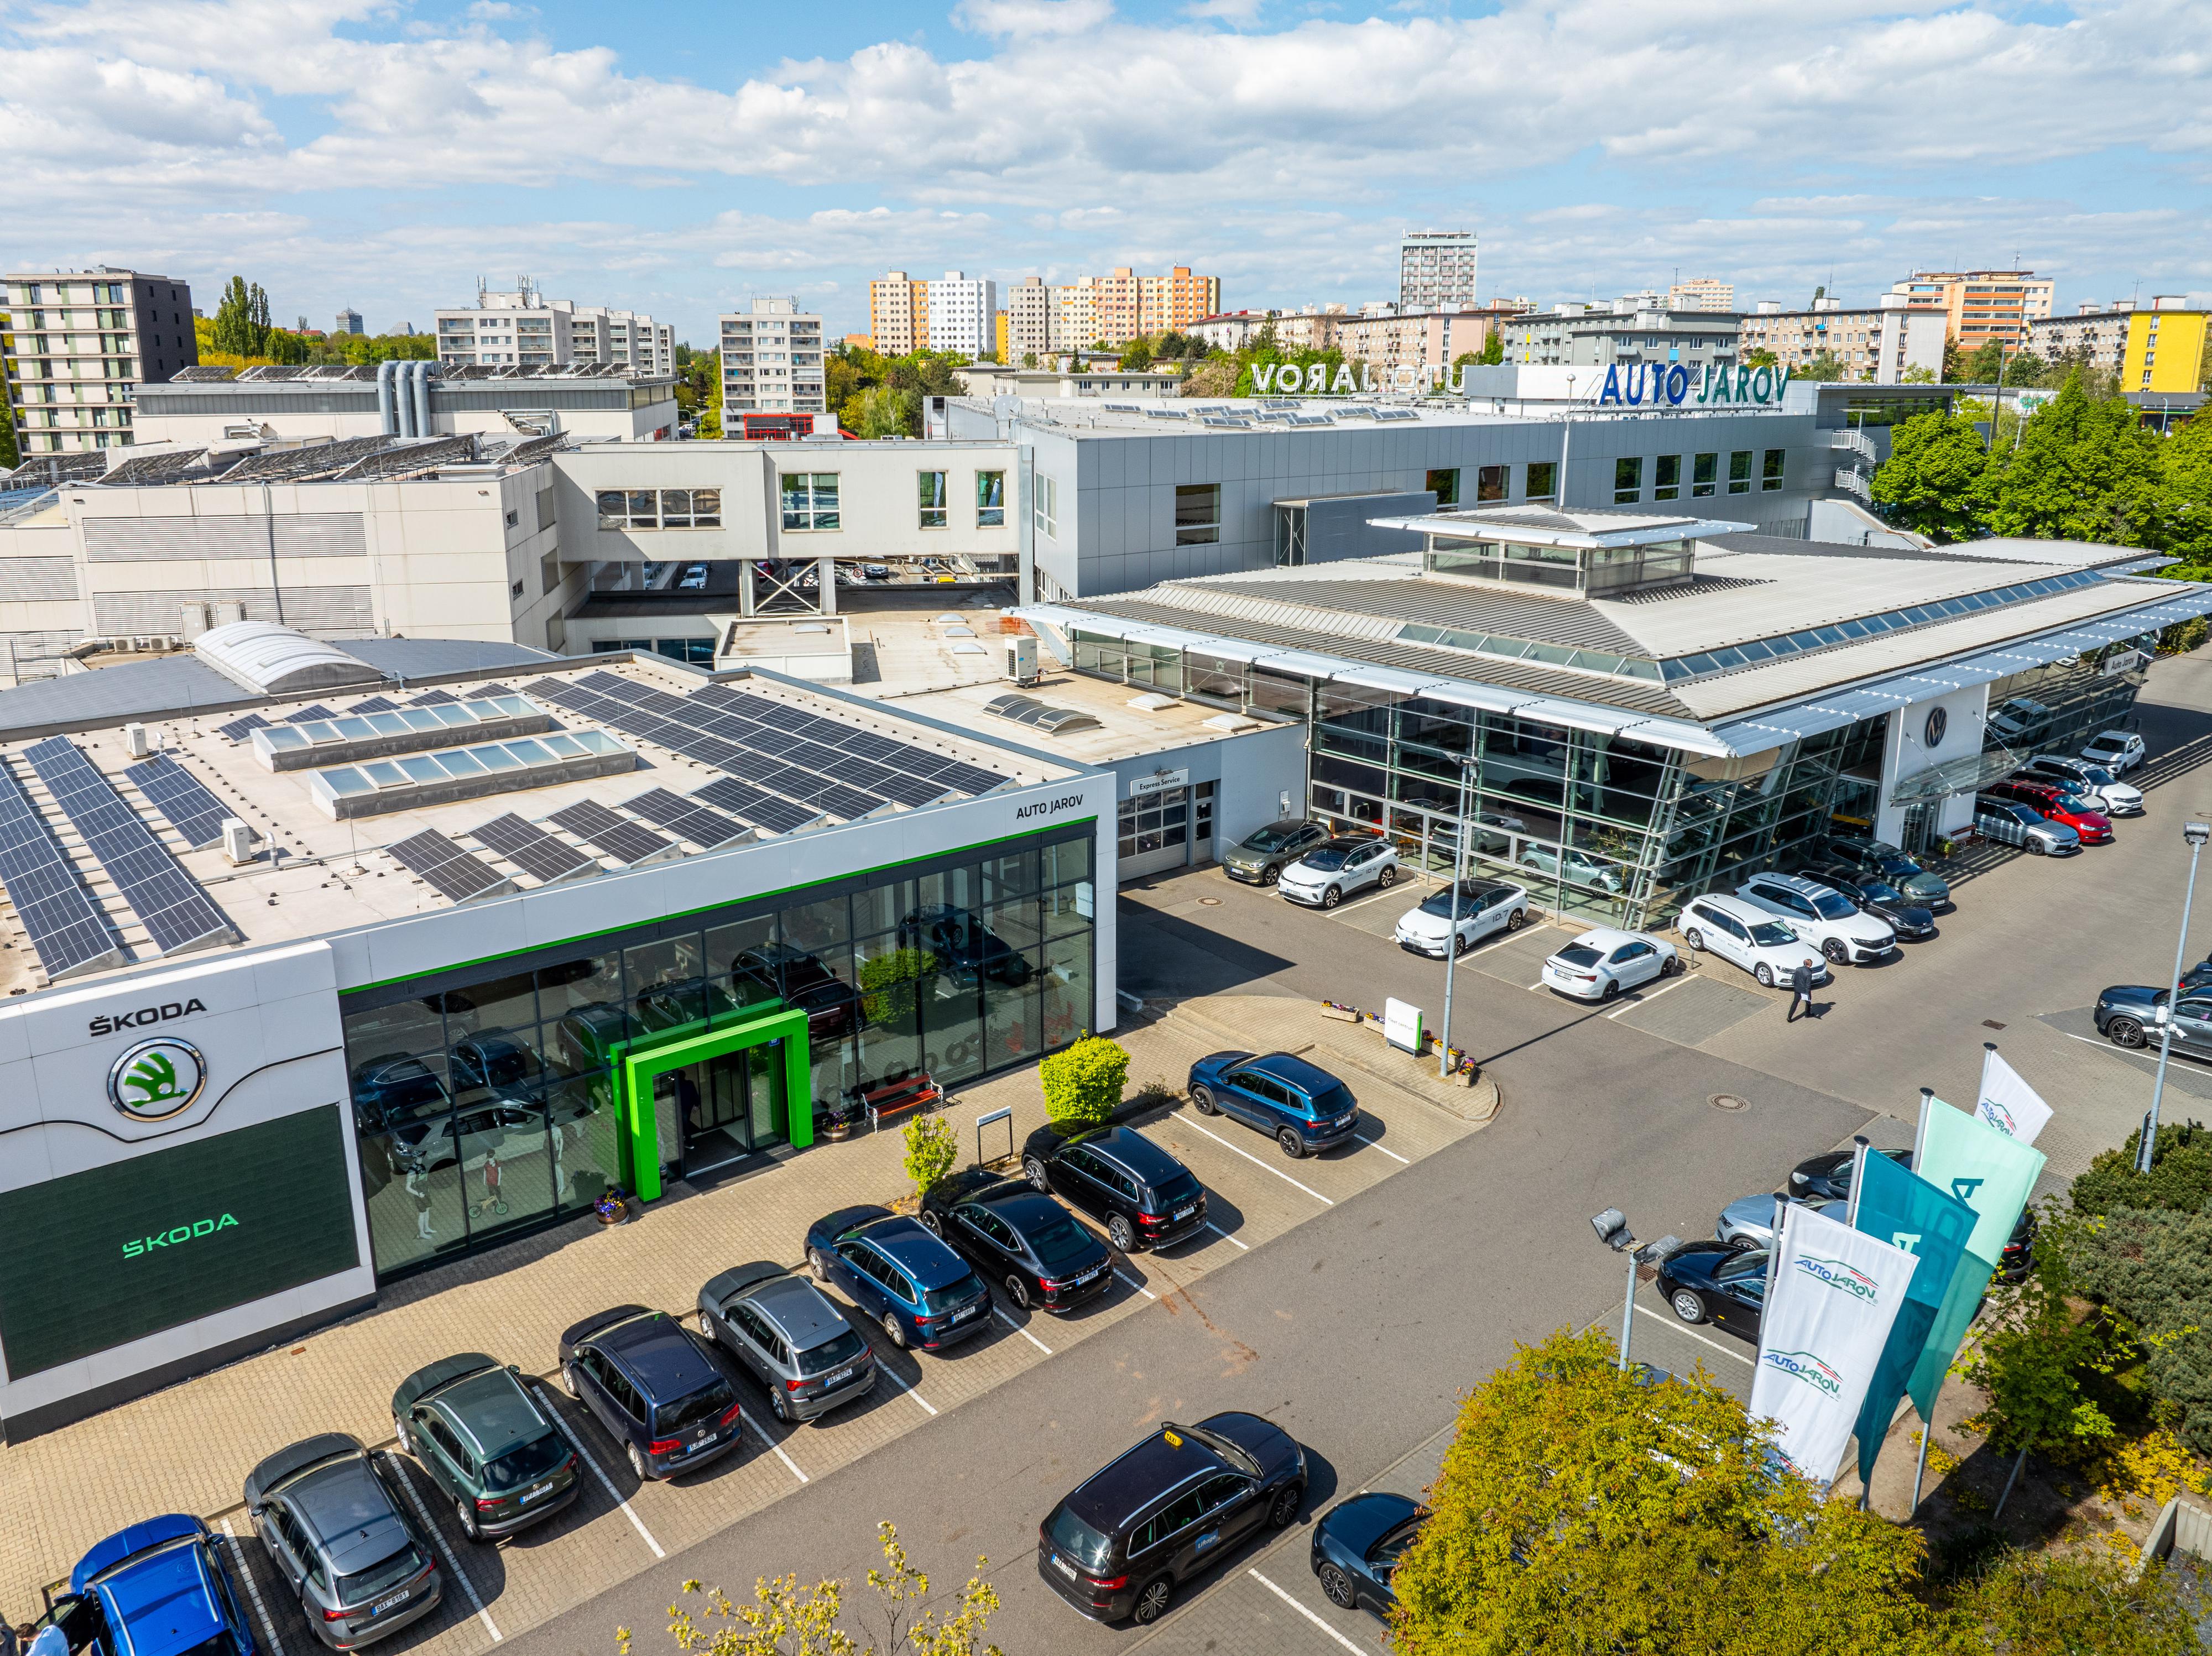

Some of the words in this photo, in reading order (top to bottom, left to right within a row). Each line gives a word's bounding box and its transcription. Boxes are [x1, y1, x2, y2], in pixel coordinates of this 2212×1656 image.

[1598, 363, 1687, 405] AUTO
[1695, 364, 1790, 404] JAROV
[1140, 782, 1160, 790] Express
[1161, 777, 1180, 785] Service
[1016, 803, 1047, 819] AUTO
[1050, 794, 1083, 814] JAROV
[1493, 909, 1509, 923] ID.7
[1701, 927, 1714, 937] Passat
[89, 998, 207, 1037] ŠKODA
[840, 1370, 851, 1378] 9274
[703, 1435, 714, 1444] 2626
[1167, 1433, 1176, 1444] TAXI
[1198, 1535, 1216, 1549] Liftago
[377, 1602, 389, 1612] 9AX
[392, 1592, 407, 1604] 8181
